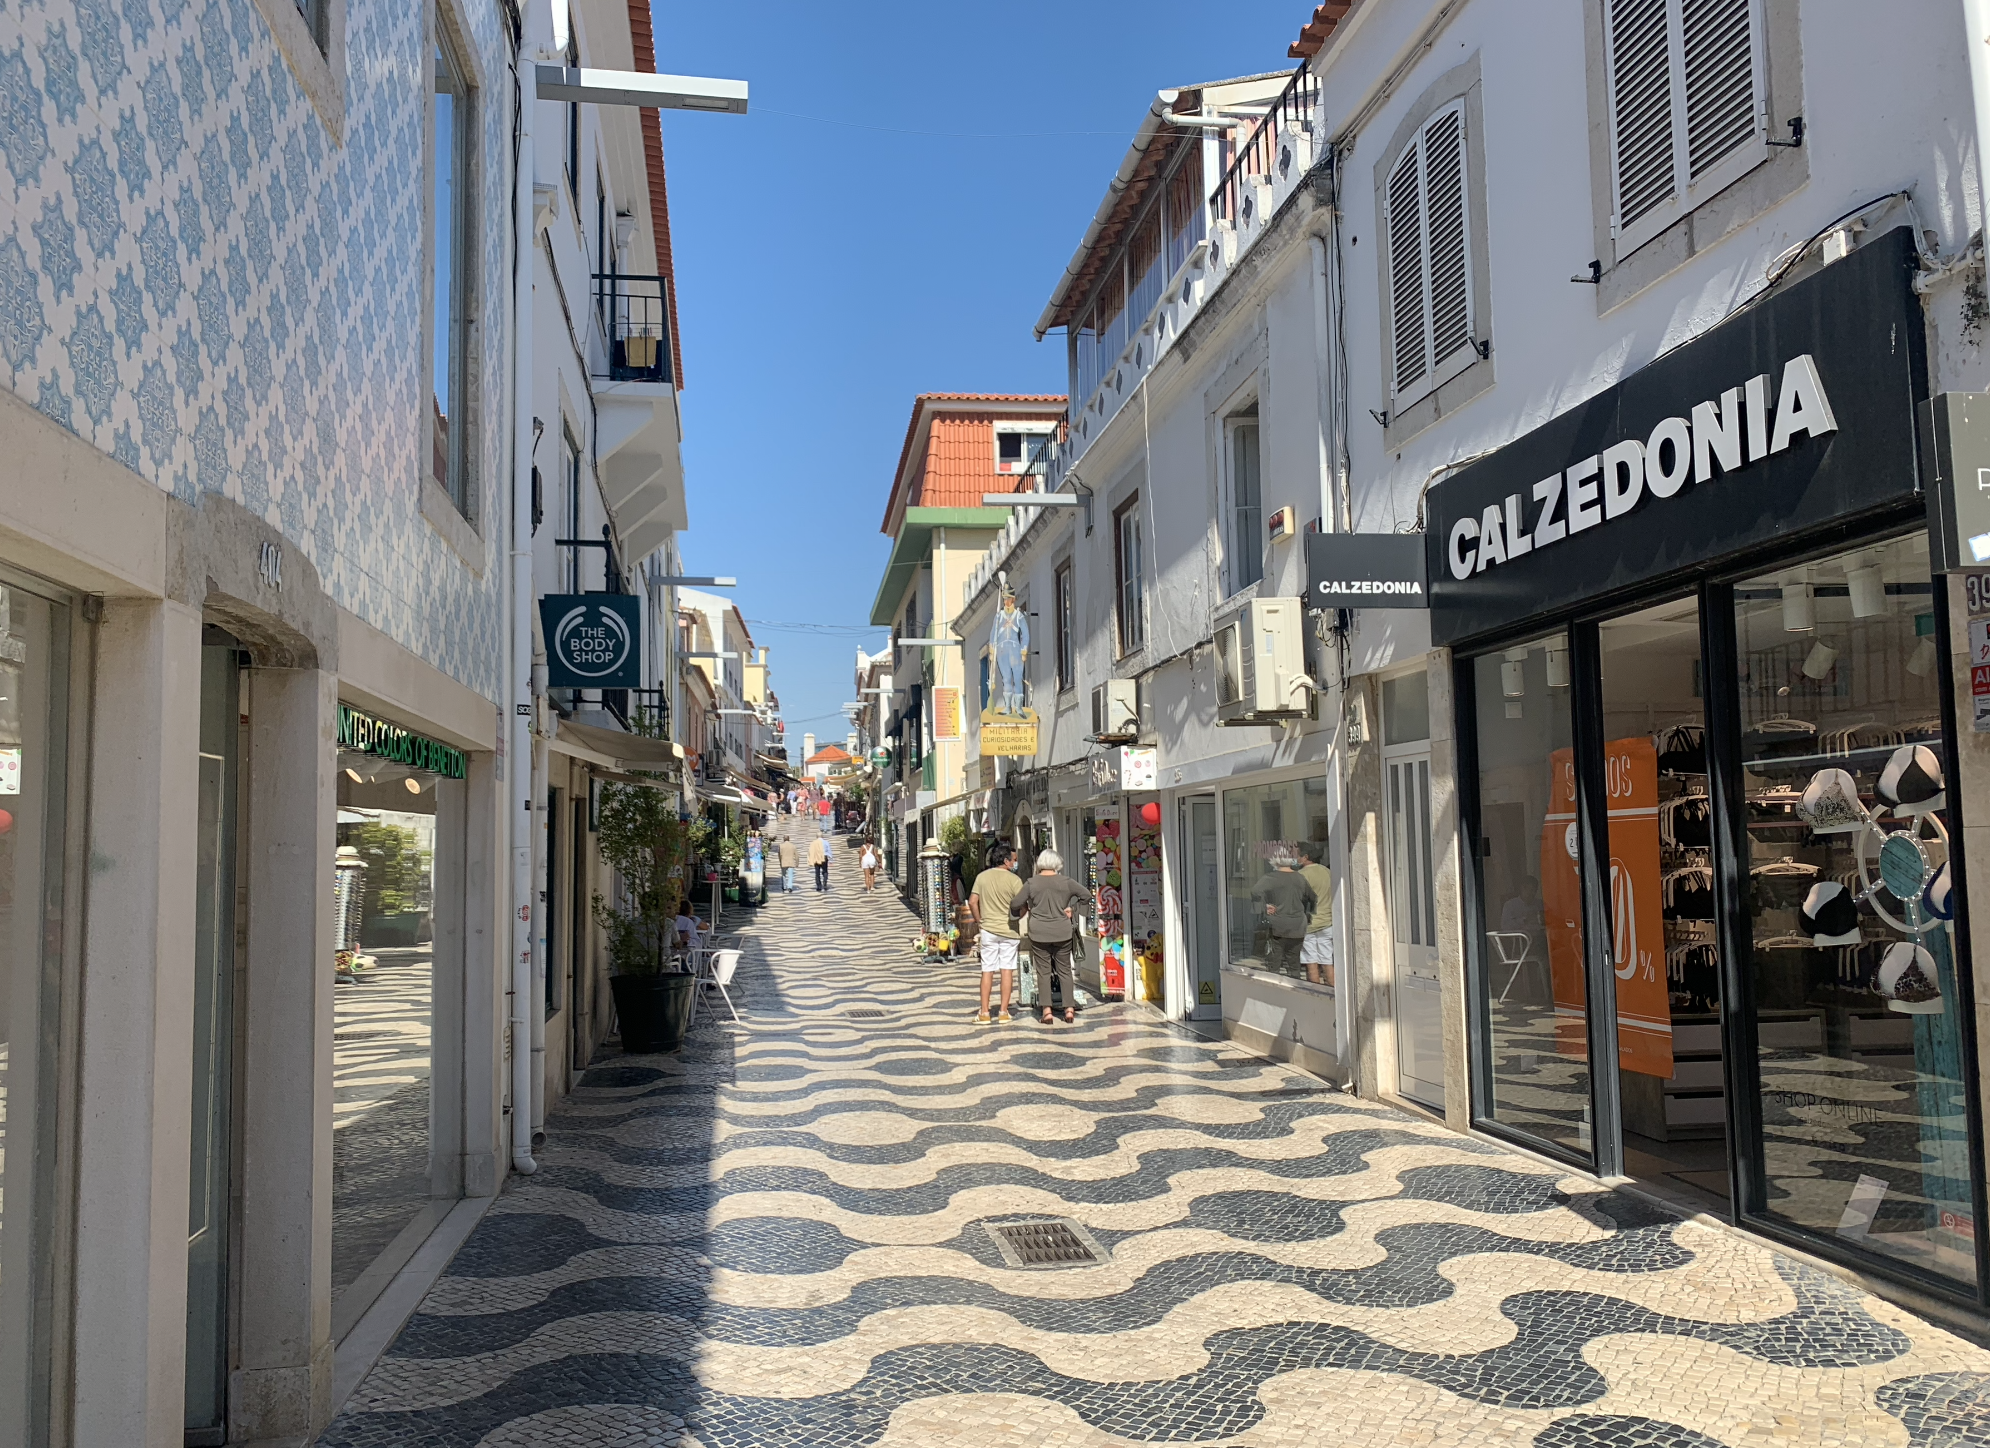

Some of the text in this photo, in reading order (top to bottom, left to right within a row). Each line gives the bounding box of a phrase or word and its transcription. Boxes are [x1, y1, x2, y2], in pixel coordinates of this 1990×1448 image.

[1448, 353, 1839, 581] CALZEDONIA
[259, 541, 282, 592] 404
[1319, 580, 1422, 596] CALZEDONIA
[579, 627, 606, 638] THE
[570, 638, 617, 651] BODY
[573, 651, 615, 664] SHOP
[989, 727, 1028, 735] MILITARIA
[375, 720, 413, 764] COLORS
[415, 736, 428, 768] OF
[428, 741, 467, 779] BENETTON
[997, 744, 1032, 752] VELHARIAS
[1775, 1088, 1884, 1127] SHOP ONLINE
